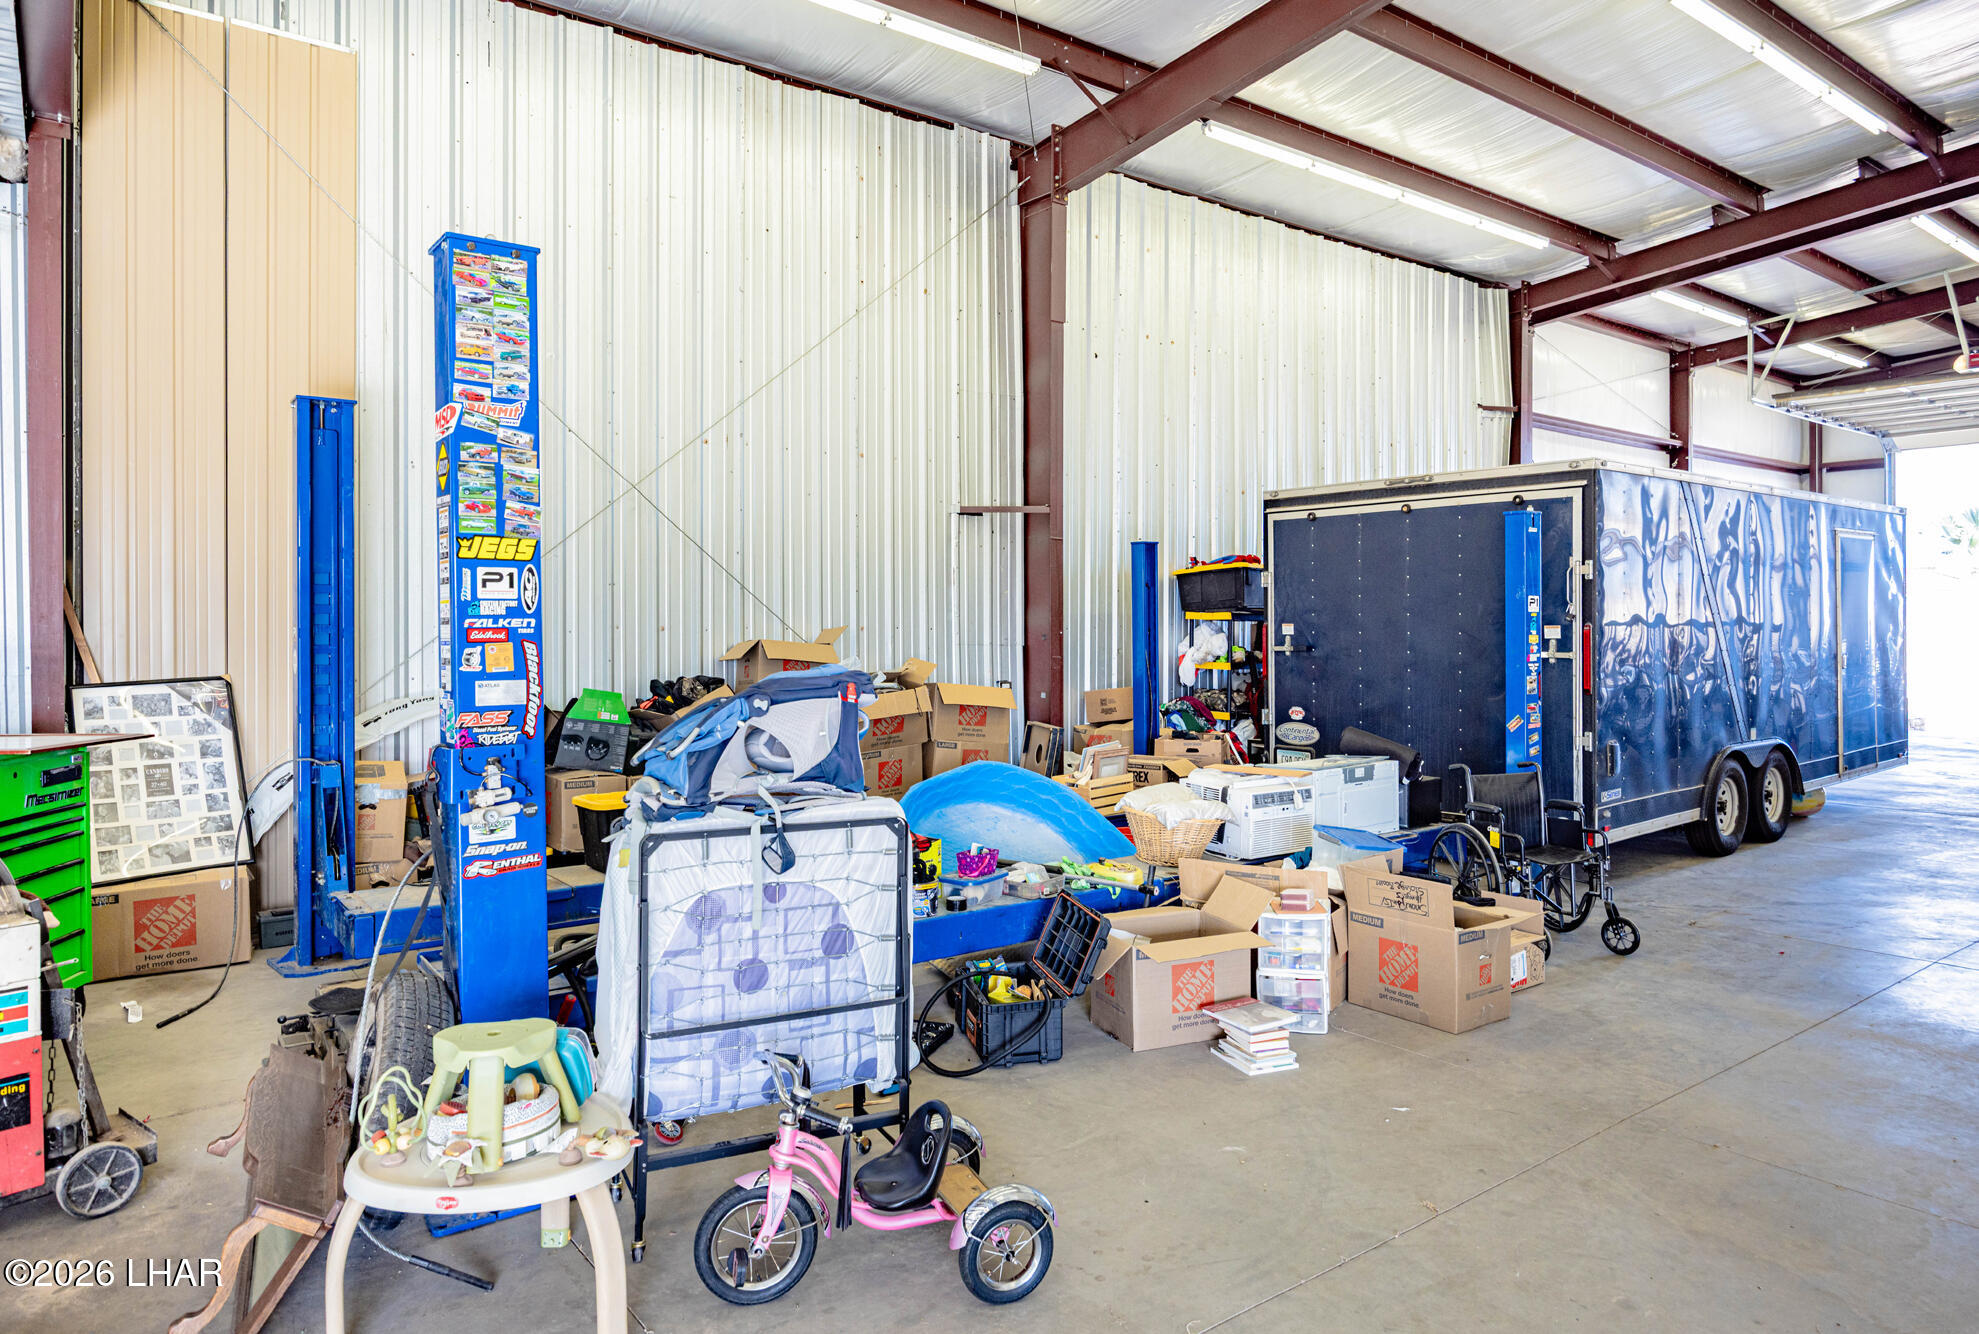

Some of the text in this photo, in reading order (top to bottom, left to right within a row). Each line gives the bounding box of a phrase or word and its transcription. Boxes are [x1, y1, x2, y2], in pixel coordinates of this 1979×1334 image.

[435, 405, 457, 432] MSD
[457, 535, 538, 561] JEGS
[482, 572, 515, 589] P1
[463, 618, 536, 628] FALKEN
[522, 640, 542, 738] Blackfoot
[455, 710, 513, 728] FASS
[566, 781, 593, 789] MEDIUM
[1128, 771, 1149, 784] REX
[462, 841, 528, 858] Snap-on
[464, 853, 542, 878] RENTHAL
[139, 903, 166, 926] THE
[1352, 913, 1381, 927] MEDIUM
[135, 895, 196, 952] HOME
[160, 913, 196, 950] DEPOT
[144, 950, 191, 962] How doers
[1379, 944, 1418, 984] HOME
[135, 963, 150, 971] get
[152, 959, 175, 968] more
[1173, 960, 1215, 1012] HOME
[1384, 986, 1397, 995] How
[1171, 1023, 1183, 1031] get
